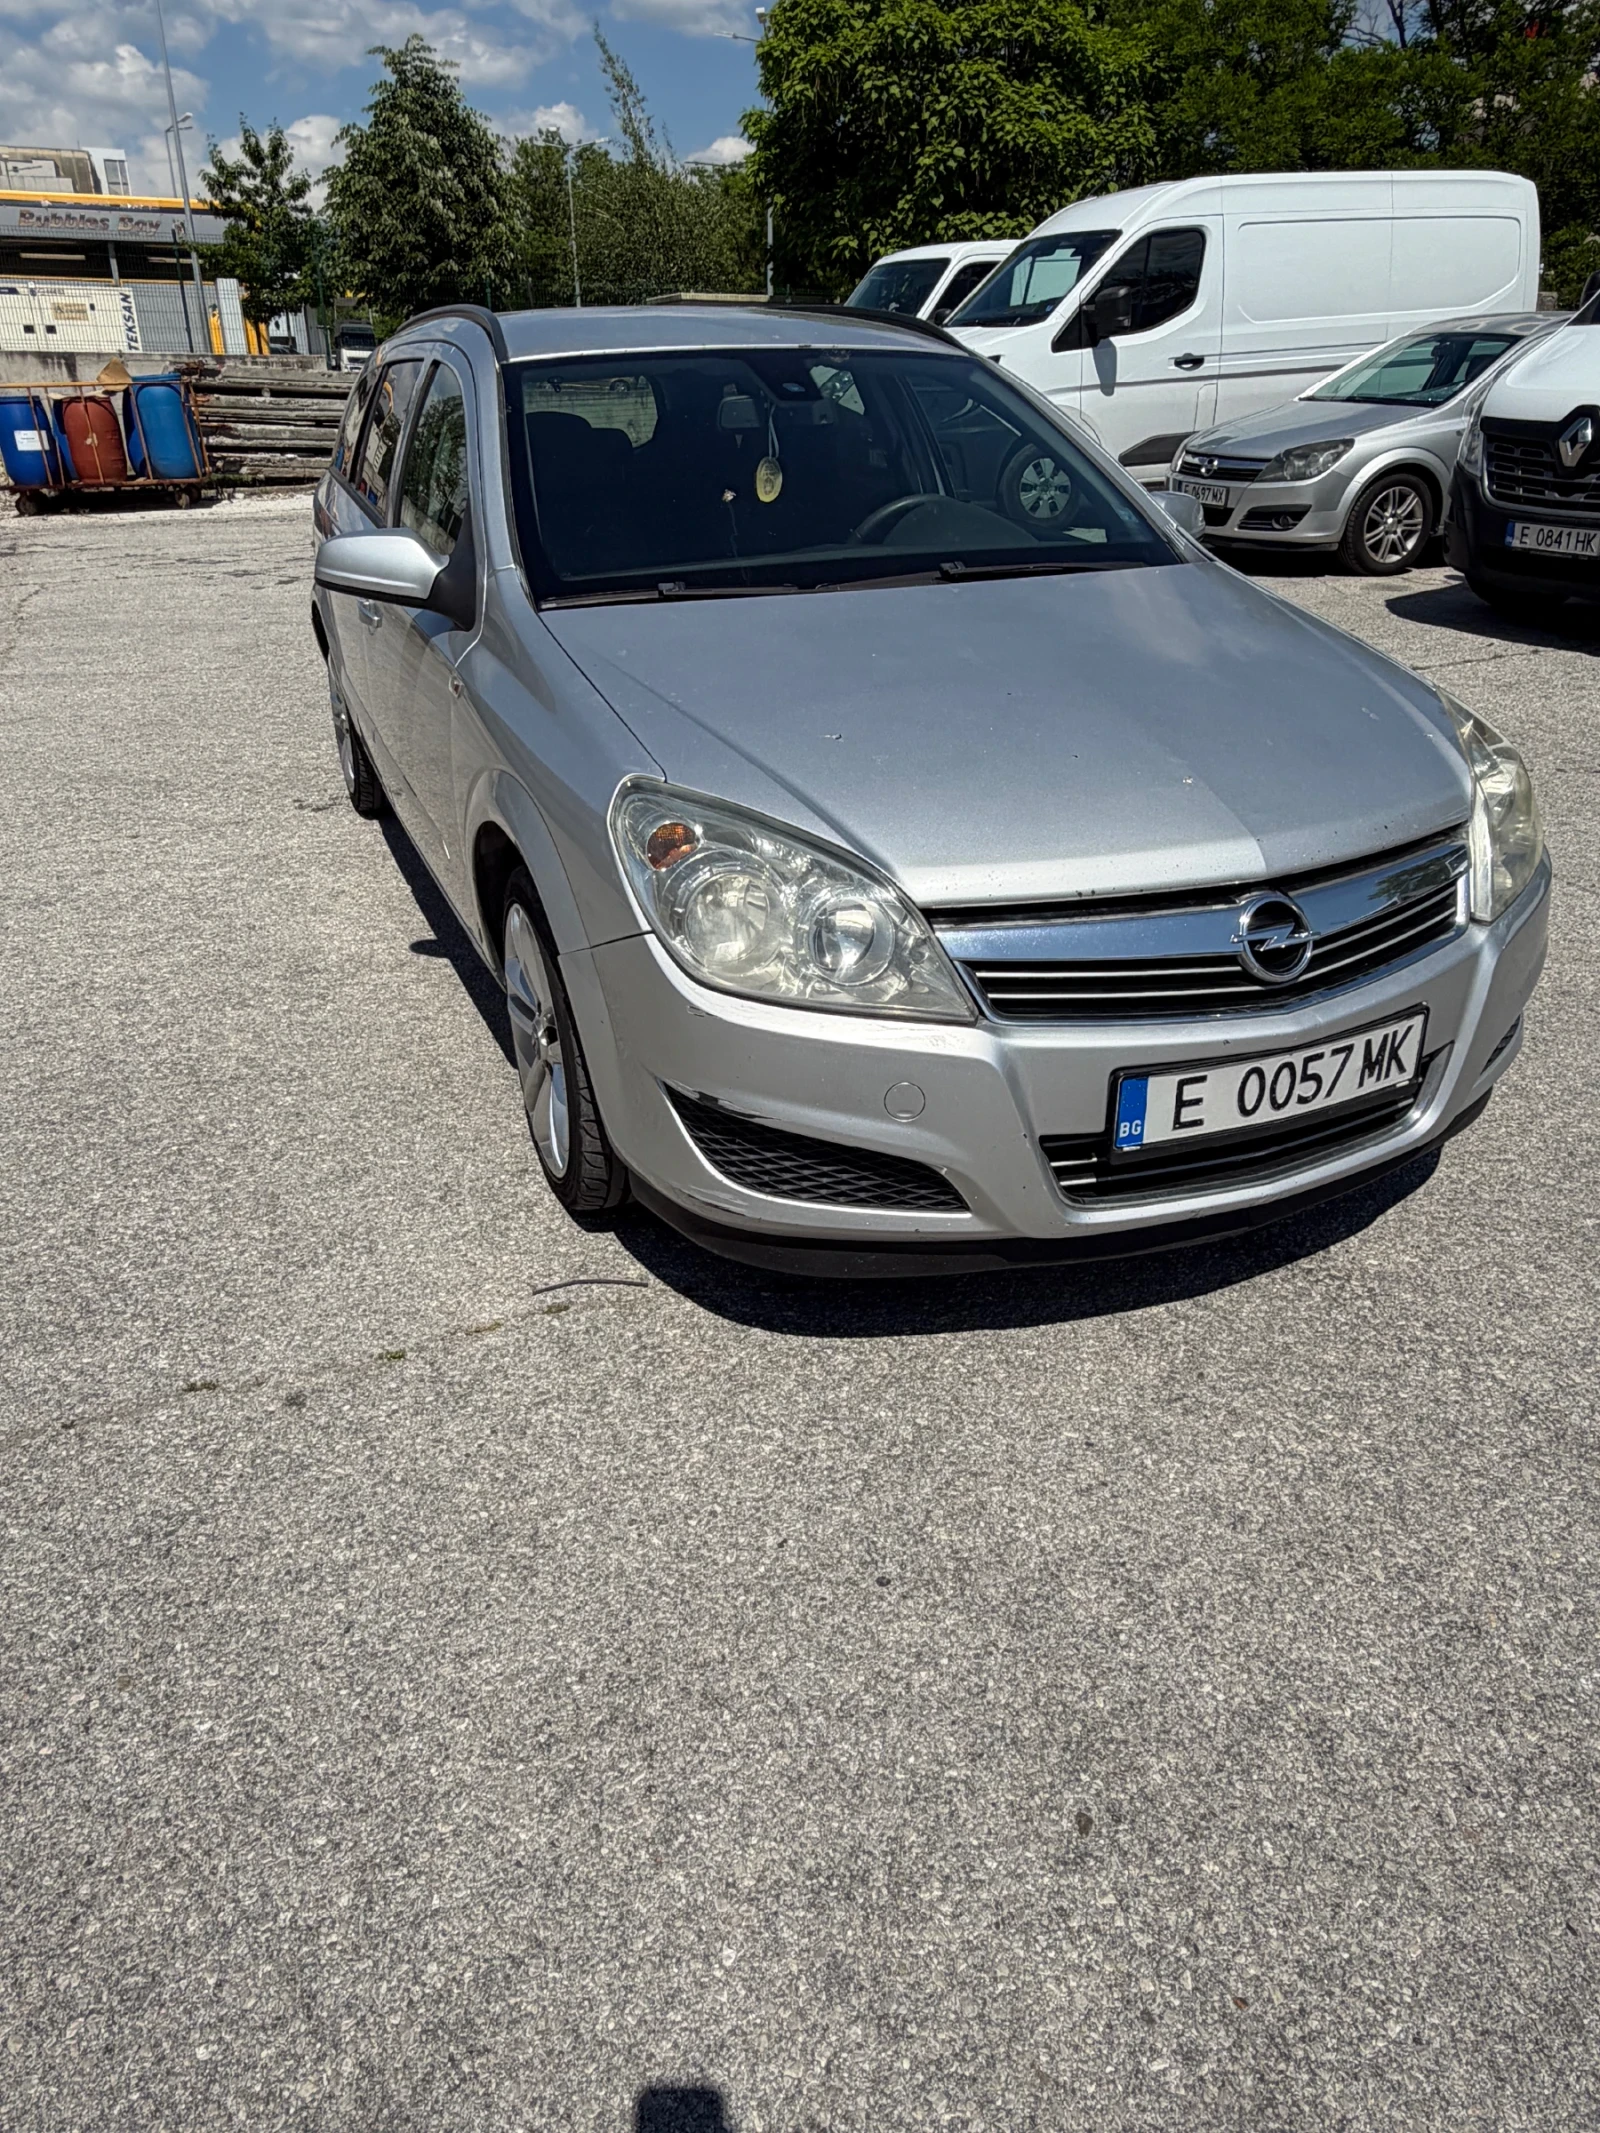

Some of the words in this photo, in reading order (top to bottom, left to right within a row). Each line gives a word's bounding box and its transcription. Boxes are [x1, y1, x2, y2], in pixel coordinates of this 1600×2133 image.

[119, 292, 140, 351] TEKSAN
[1520, 526, 1531, 545] E
[1536, 528, 1572, 550] 0841
[1575, 531, 1597, 553] HK
[1172, 1075, 1208, 1131] E
[1237, 1044, 1355, 1118] 0057
[1357, 1024, 1414, 1089] MK
[1119, 1120, 1142, 1139] BG
